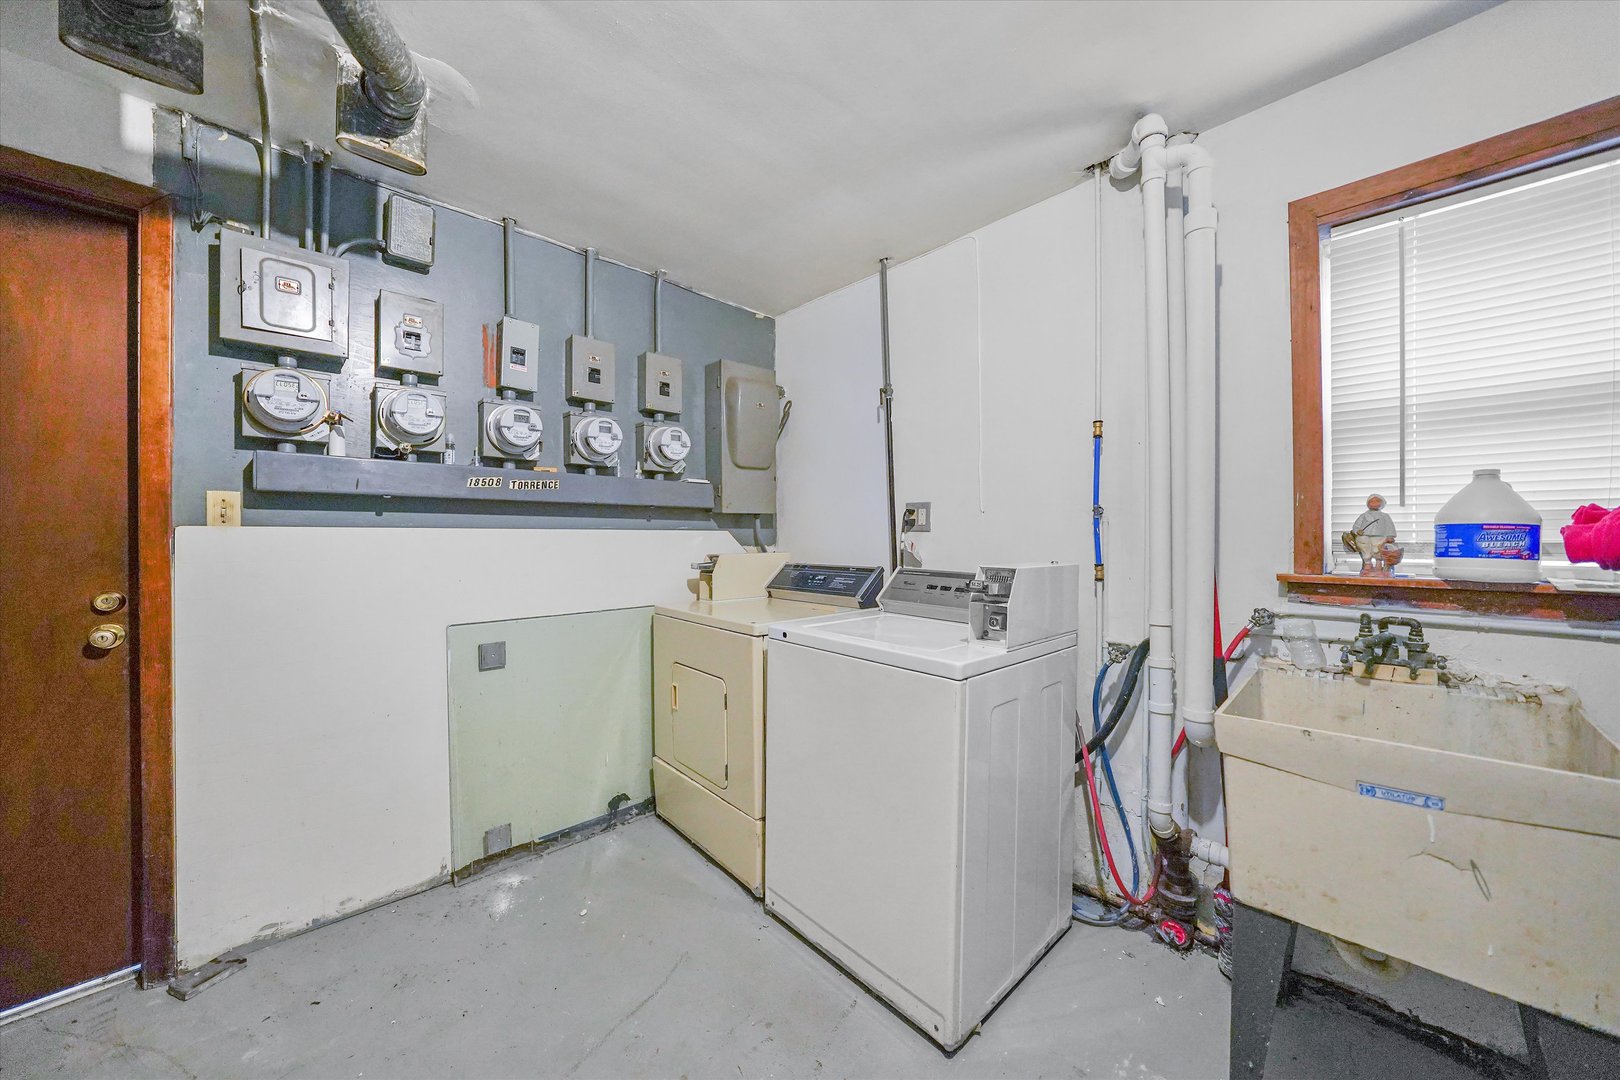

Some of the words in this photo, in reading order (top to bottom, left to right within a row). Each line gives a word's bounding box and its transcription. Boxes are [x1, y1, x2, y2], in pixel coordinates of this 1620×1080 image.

[468, 478, 501, 487] 18508
[511, 480, 559, 490] TORRENCE
[1476, 532, 1527, 541] AWESOME
[1481, 541, 1526, 549] BLEACH
